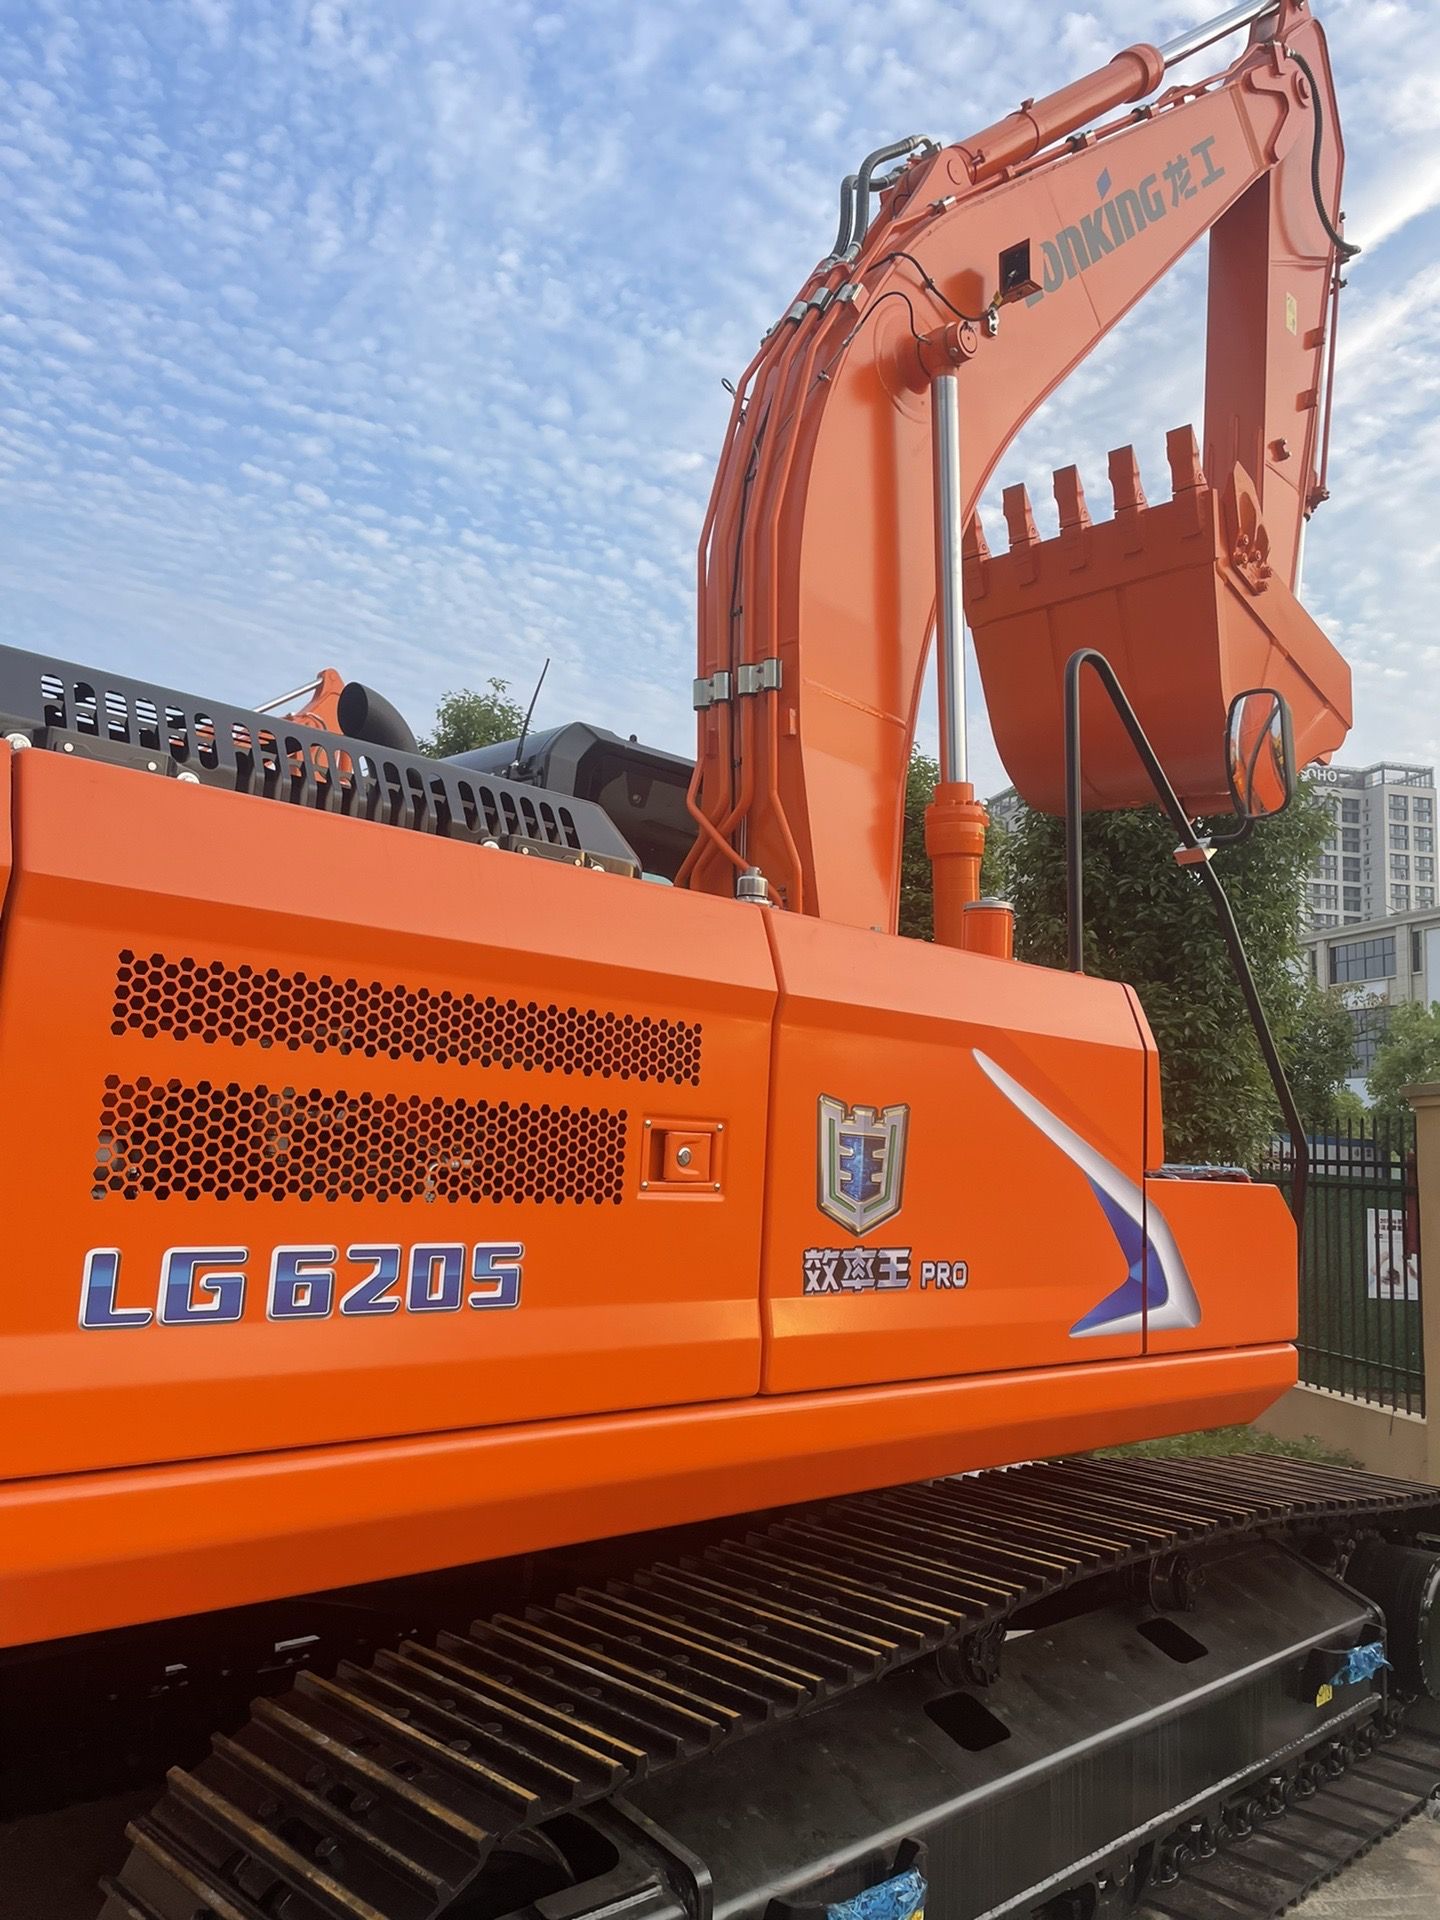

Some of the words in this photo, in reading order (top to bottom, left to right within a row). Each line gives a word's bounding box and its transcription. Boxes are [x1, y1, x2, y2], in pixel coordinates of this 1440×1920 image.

[1163, 136, 1226, 208] 龙工
[79, 1245, 251, 1331] LG
[803, 1245, 912, 1295] 效率王
[920, 1261, 969, 1290] PRO
